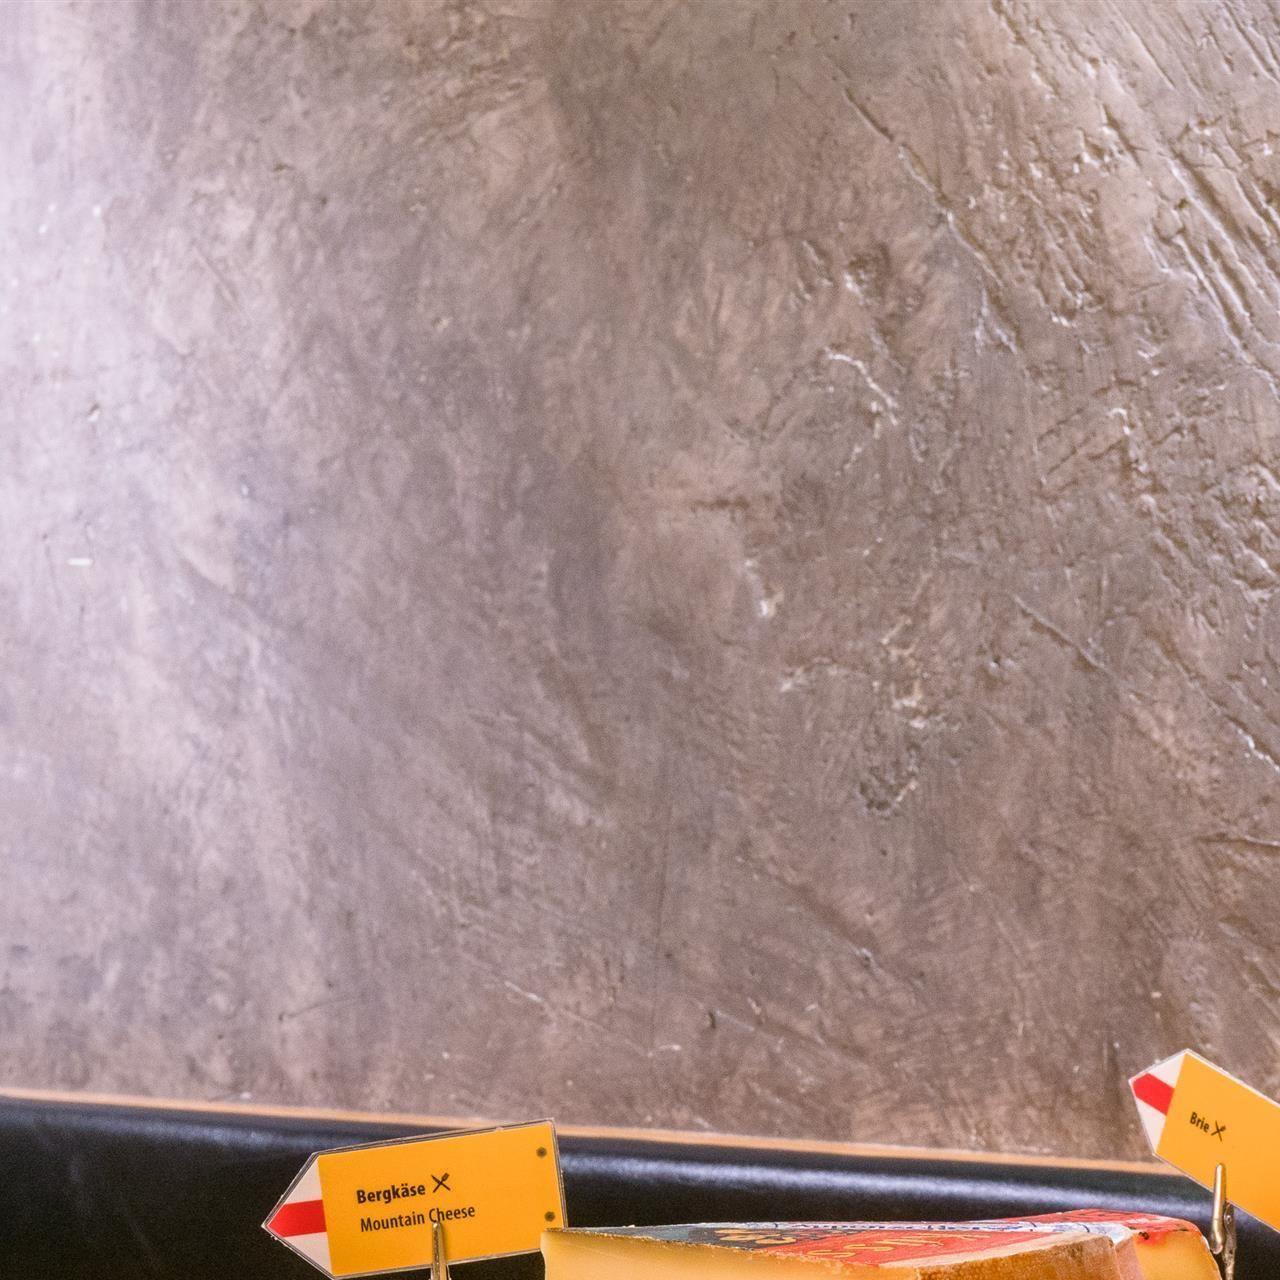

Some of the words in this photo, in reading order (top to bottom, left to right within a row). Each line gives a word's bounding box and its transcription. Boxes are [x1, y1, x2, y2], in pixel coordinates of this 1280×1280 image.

[1190, 1111, 1210, 1133] Brie
[356, 1183, 426, 1204] Bergkäse
[360, 1211, 425, 1232] Mountain
[428, 1206, 476, 1223] Cheese
